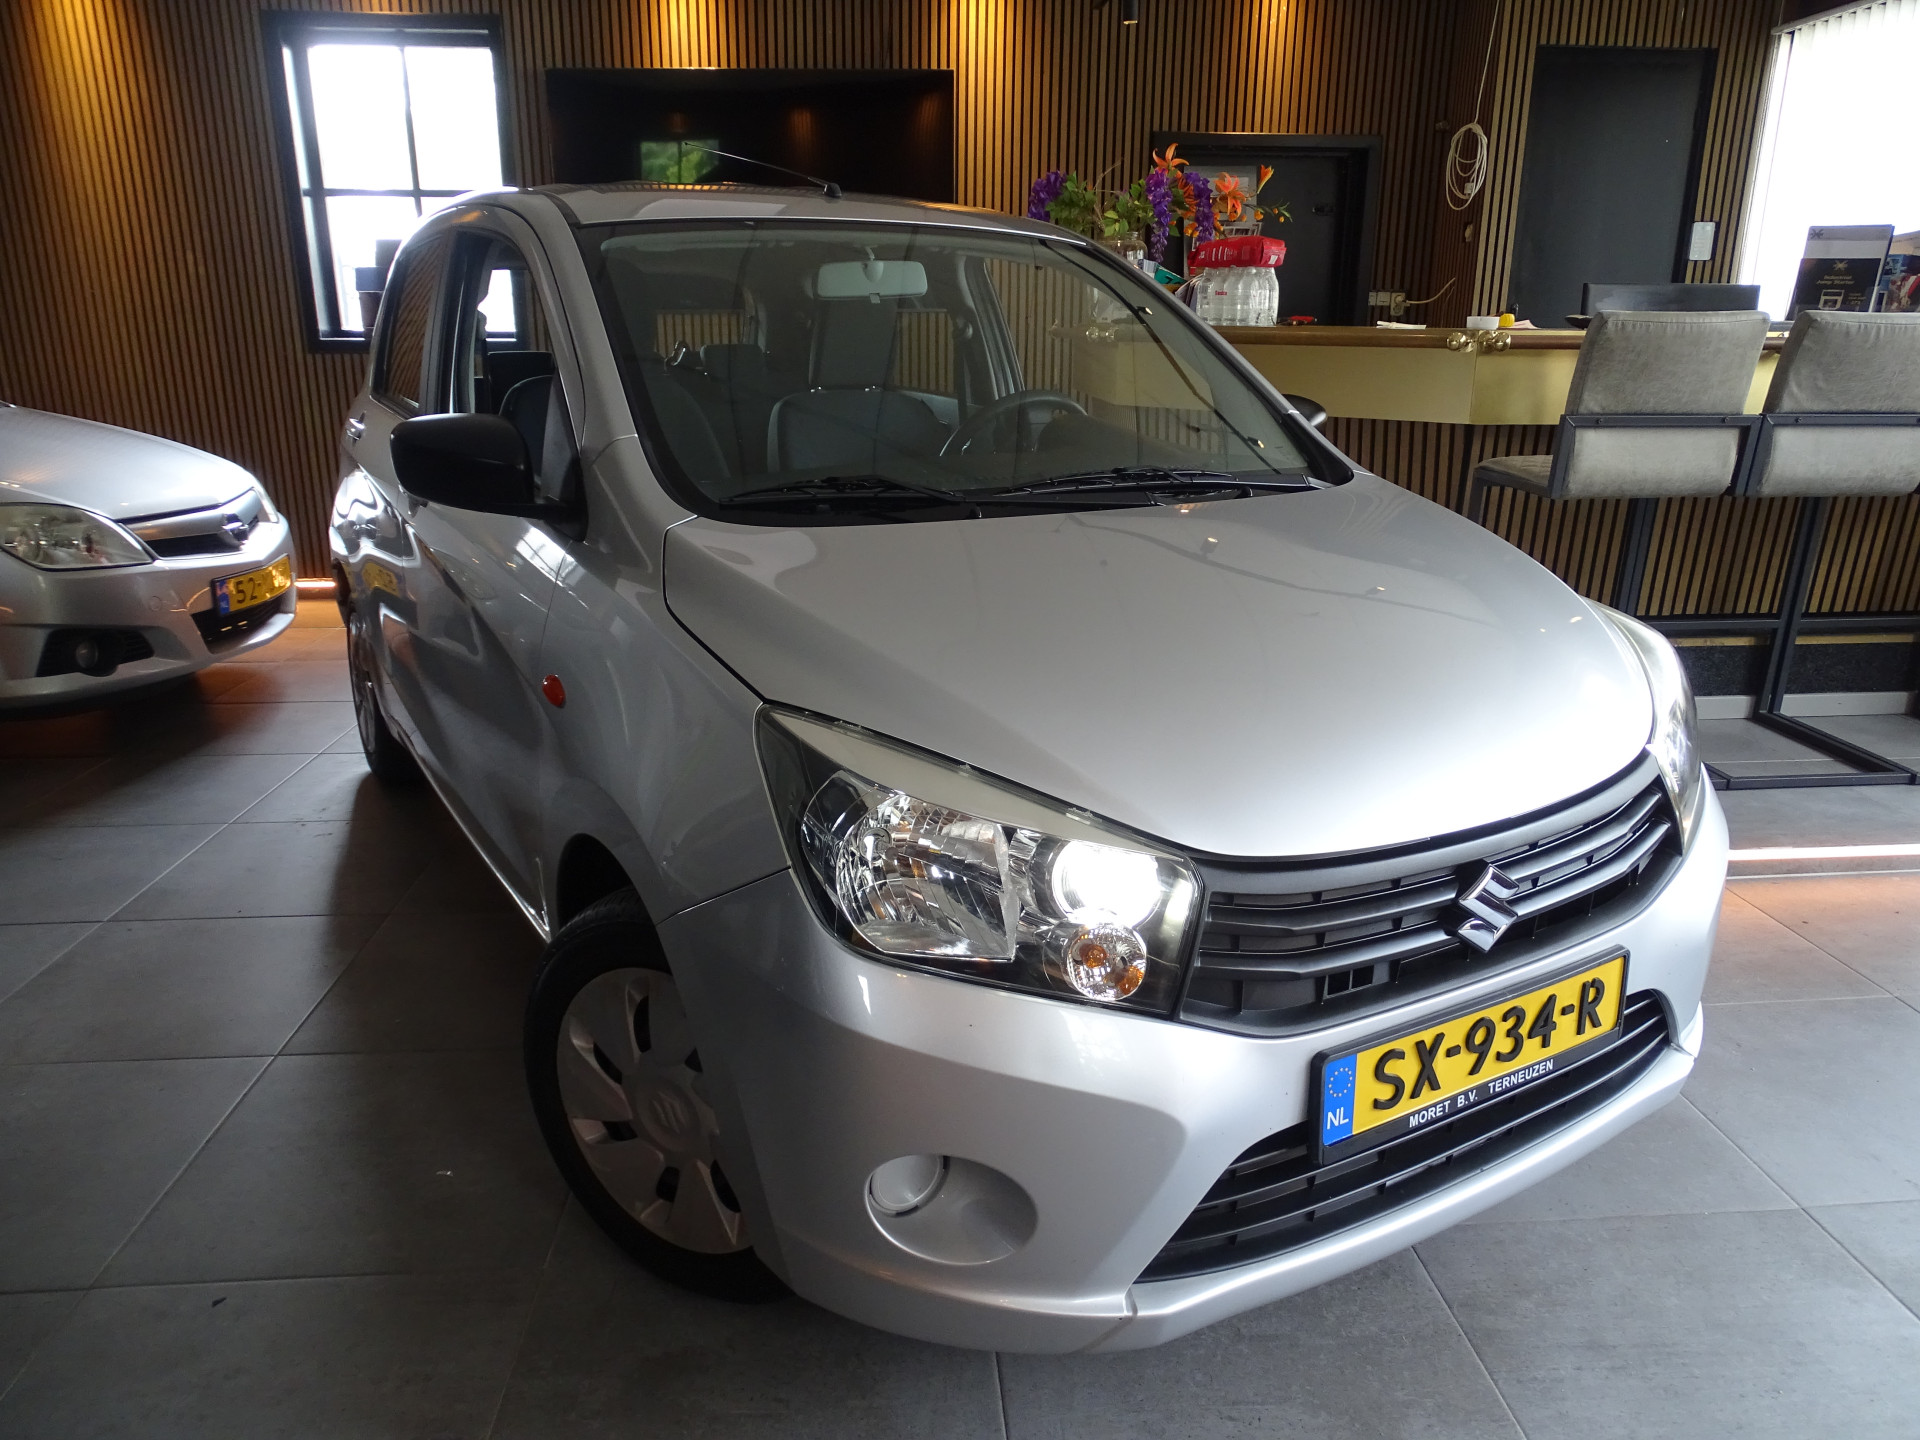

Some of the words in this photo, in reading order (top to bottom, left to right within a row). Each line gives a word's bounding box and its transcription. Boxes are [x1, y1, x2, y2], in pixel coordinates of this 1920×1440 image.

[1373, 977, 1606, 1111] SX-934-R
[1326, 1106, 1350, 1131] NL
[1409, 1100, 1451, 1129] MORET
[1457, 1090, 1479, 1108] B.V.
[1488, 1058, 1555, 1095] TERNEUZEN
